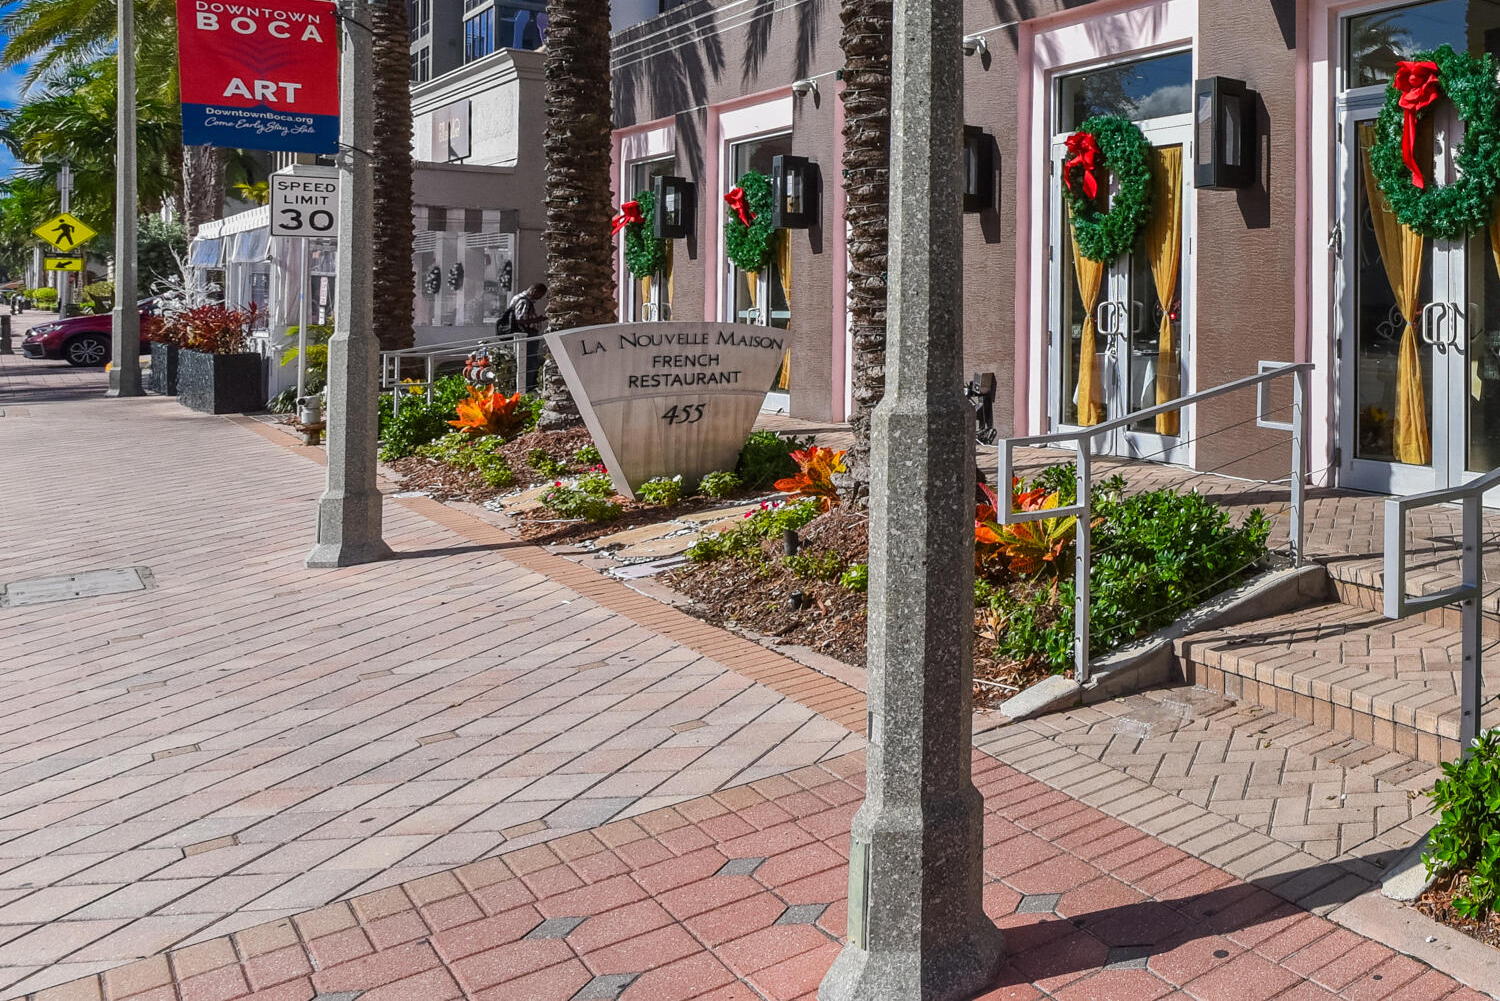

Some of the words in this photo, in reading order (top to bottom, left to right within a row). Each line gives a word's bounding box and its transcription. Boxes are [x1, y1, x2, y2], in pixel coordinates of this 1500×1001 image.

[195, 0, 320, 24] DOWNTOWN
[196, 11, 323, 43] BOCA
[222, 77, 303, 103] ART
[204, 117, 235, 127] Come
[205, 107, 314, 125] DowntownBoca.org
[278, 181, 336, 193] SPEED
[283, 194, 329, 206] LIMIT
[278, 208, 334, 232] 30
[580, 339, 607, 356] LA
[619, 332, 709, 350] NOUVELLE
[715, 330, 784, 350] MAISON
[652, 353, 720, 368] FRENCH
[628, 371, 742, 388] RESTAURANT
[661, 403, 706, 425] 455
